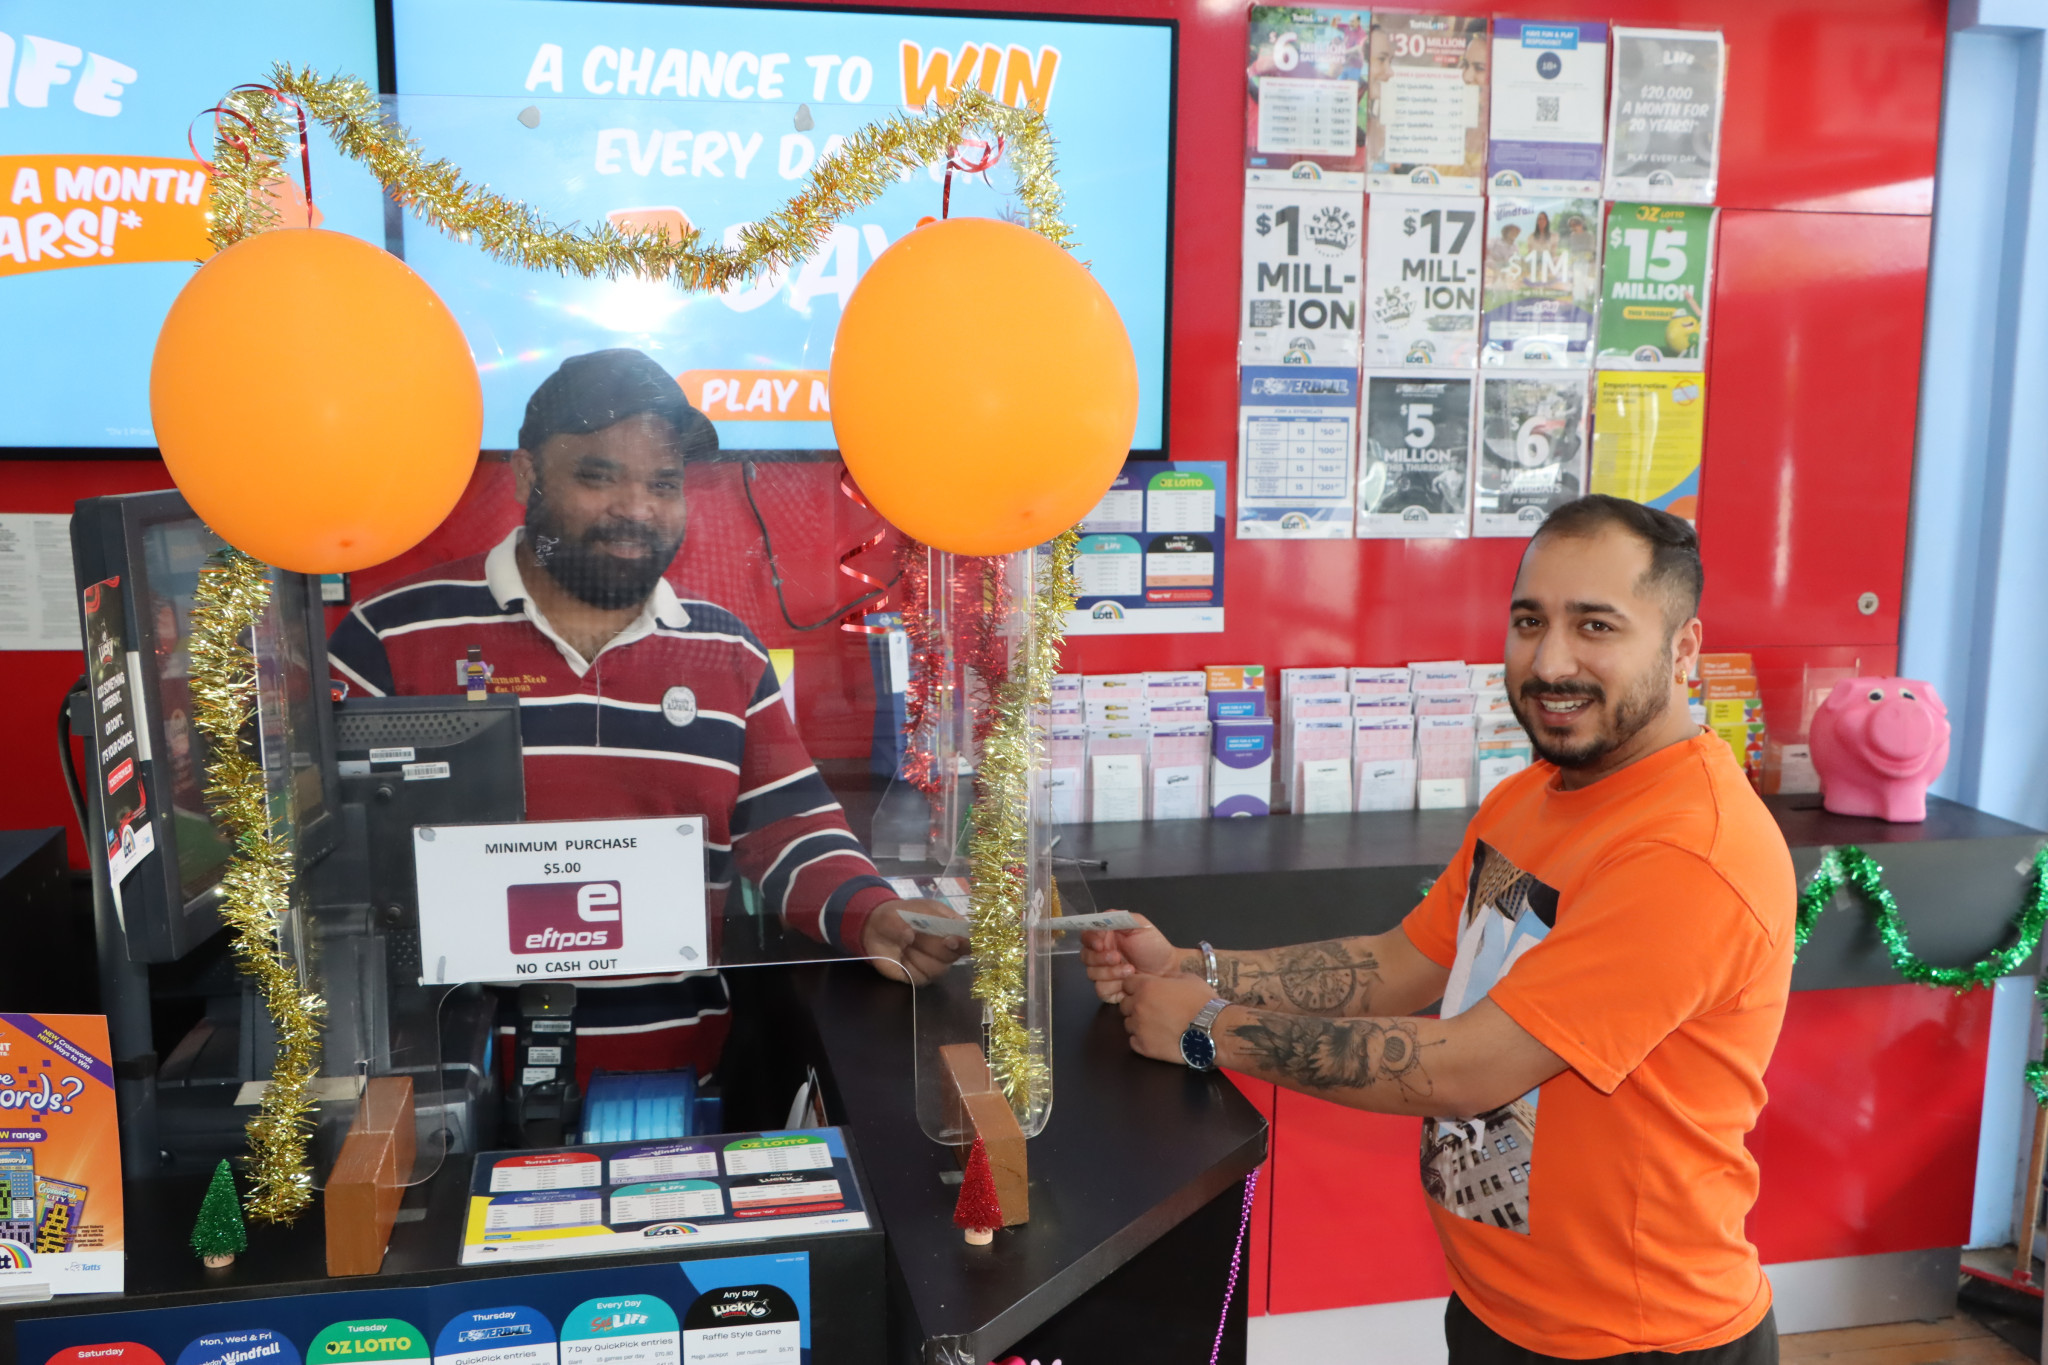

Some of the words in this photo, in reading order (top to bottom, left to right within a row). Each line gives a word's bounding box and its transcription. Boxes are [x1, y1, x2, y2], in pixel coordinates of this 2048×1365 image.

[524, 43, 563, 93] A
[582, 46, 790, 99] CHANCE
[804, 54, 873, 101] TO
[899, 40, 1060, 116] WIN
[1640, 86, 1693, 100] $20,000
[1622, 103, 1632, 115] A
[1634, 103, 1680, 116] MONTH
[1683, 104, 1709, 117] FOR
[1629, 118, 1645, 131] 20
[594, 128, 763, 178] EVERY
[1626, 154, 1649, 162] PLAY
[1651, 154, 1677, 162] EVERY
[1679, 155, 1697, 163] DAY
[12, 168, 42, 204] A
[55, 165, 207, 205] MONTH
[1636, 206, 1662, 222] OZ
[1403, 209, 1476, 254] $17
[1610, 226, 1687, 282] $15
[1402, 258, 1477, 283] MILL-
[1508, 249, 1569, 283] $1M
[1257, 262, 1356, 293] MILL-
[1425, 286, 1476, 310] ION
[1611, 282, 1695, 302] MILLION
[1288, 299, 1355, 330] ION
[701, 378, 799, 412] PLAY
[1400, 403, 1435, 448] $5
[1384, 448, 1451, 463] MILLION
[1160, 479, 1173, 488] OZ
[1174, 478, 1203, 487] LOTTO
[1092, 611, 1113, 620] Lott
[484, 840, 558, 855] MINIMUM
[565, 837, 638, 851] PURCHASE
[543, 862, 582, 876] $5.00
[577, 883, 620, 923] e
[525, 927, 608, 950] eftpos
[516, 962, 538, 975] NO
[545, 961, 581, 973] CASH
[588, 958, 618, 971] OUT
[37, 1033, 54, 1046] NEW
[53, 1043, 71, 1058] Ways
[70, 1054, 78, 1062] to
[77, 1059, 91, 1070] Win
[43, 1029, 60, 1042] NEW
[59, 1039, 94, 1064] Crosswords
[12, 1131, 42, 1141] range
[764, 1138, 808, 1147] LOTTO
[46, 1193, 67, 1203] CITY
[81, 1263, 101, 1271] Tatts
[723, 1291, 740, 1299] Any
[742, 1289, 759, 1298] Day
[596, 1301, 621, 1310] Every
[624, 1299, 641, 1309] Day
[711, 1301, 755, 1318] Lucky
[472, 1311, 517, 1322] Thursday
[612, 1312, 648, 1327] LIFE
[347, 1323, 388, 1333] Tuesday
[458, 1323, 533, 1343] POWERBALL
[702, 1333, 729, 1341] Raffle
[730, 1330, 753, 1339] Style
[755, 1328, 782, 1336] Game
[200, 1338, 224, 1347] Mon,
[225, 1334, 248, 1344] Wed
[249, 1334, 258, 1342] &
[259, 1331, 272, 1340] Fri
[325, 1339, 352, 1355] OZ
[355, 1336, 411, 1354] LOTTO
[575, 1345, 592, 1354] Day
[594, 1341, 639, 1351] QuickPick
[641, 1338, 674, 1347] entries
[77, 1348, 124, 1359] Saturday
[221, 1341, 281, 1364] Windfall
[455, 1354, 502, 1365] QuickPick
[503, 1350, 537, 1361] entries
[604, 1355, 622, 1363] games
[691, 1352, 706, 1360] Mega
[707, 1351, 729, 1359] Jackpot
